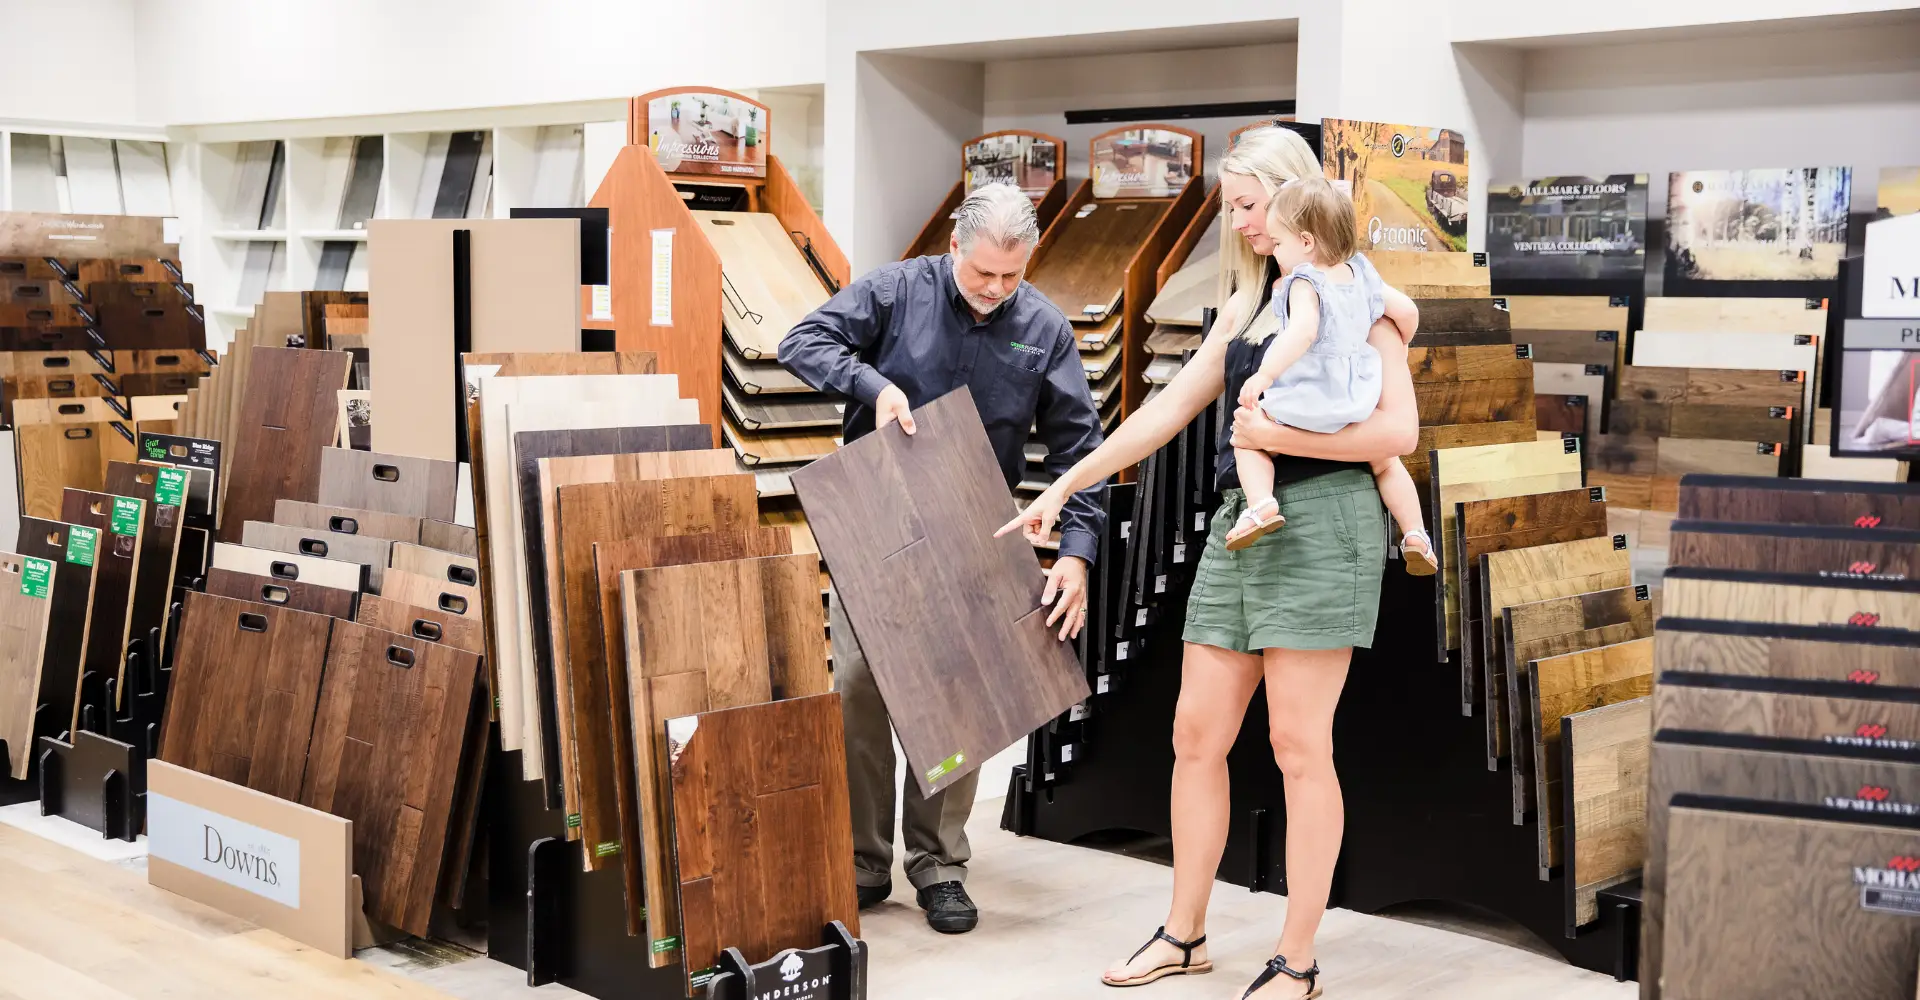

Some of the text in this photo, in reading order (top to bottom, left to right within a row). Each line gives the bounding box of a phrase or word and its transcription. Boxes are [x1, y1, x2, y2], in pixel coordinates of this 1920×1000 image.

[656, 136, 720, 159] Impressions
[1522, 182, 1626, 196] HALLMARK FLOORS
[1513, 241, 1556, 251] VENTURA
[203, 824, 278, 886] Downs
[1853, 867, 1920, 889] MOHA
